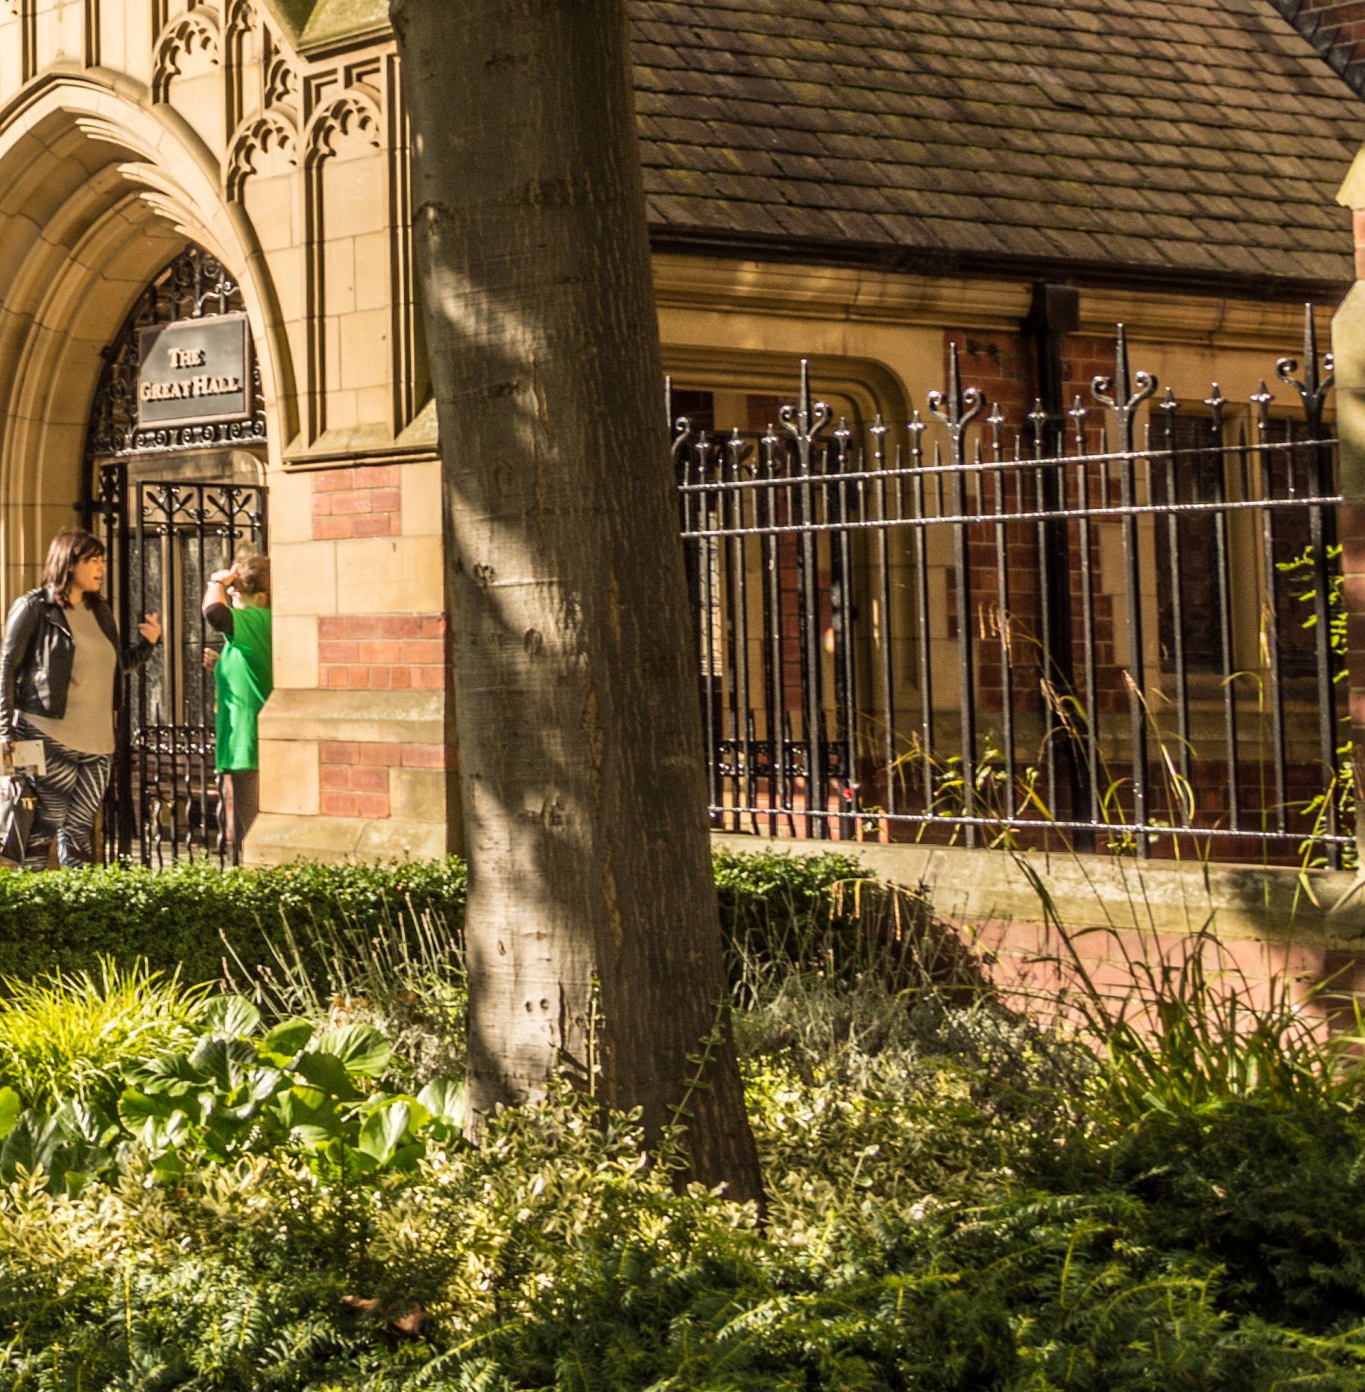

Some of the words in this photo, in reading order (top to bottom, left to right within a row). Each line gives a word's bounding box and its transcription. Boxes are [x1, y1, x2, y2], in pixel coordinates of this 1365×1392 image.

[168, 347, 202, 368] THE
[140, 380, 191, 402] GREAT
[192, 374, 239, 397] HALL
